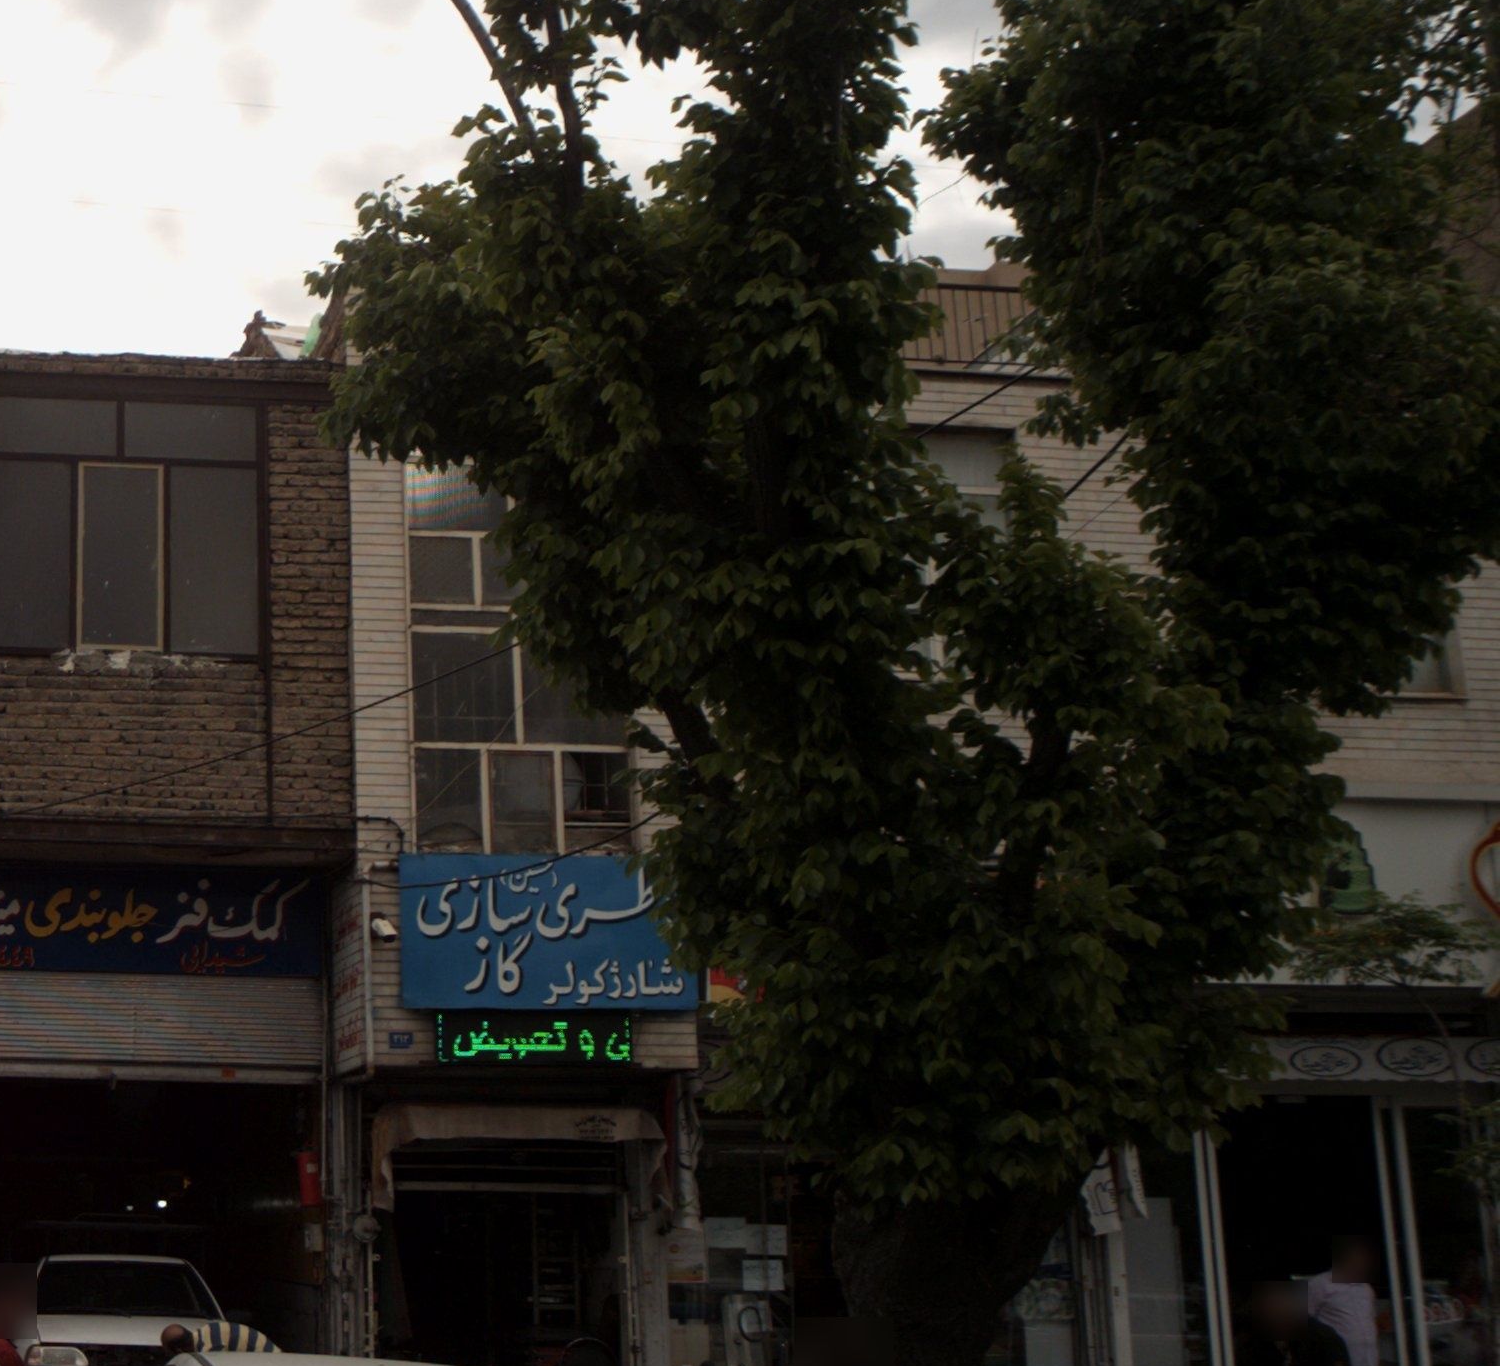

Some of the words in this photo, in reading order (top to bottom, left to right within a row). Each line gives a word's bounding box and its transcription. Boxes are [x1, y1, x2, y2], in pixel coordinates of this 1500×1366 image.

[22, 885, 160, 944] جلوبندی
[155, 878, 211, 944] فنر
[206, 878, 310, 941] کمک
[416, 875, 533, 937] سازی
[463, 932, 533, 995] گاز
[542, 958, 610, 1006] کولر
[608, 958, 686, 999] شارژ
